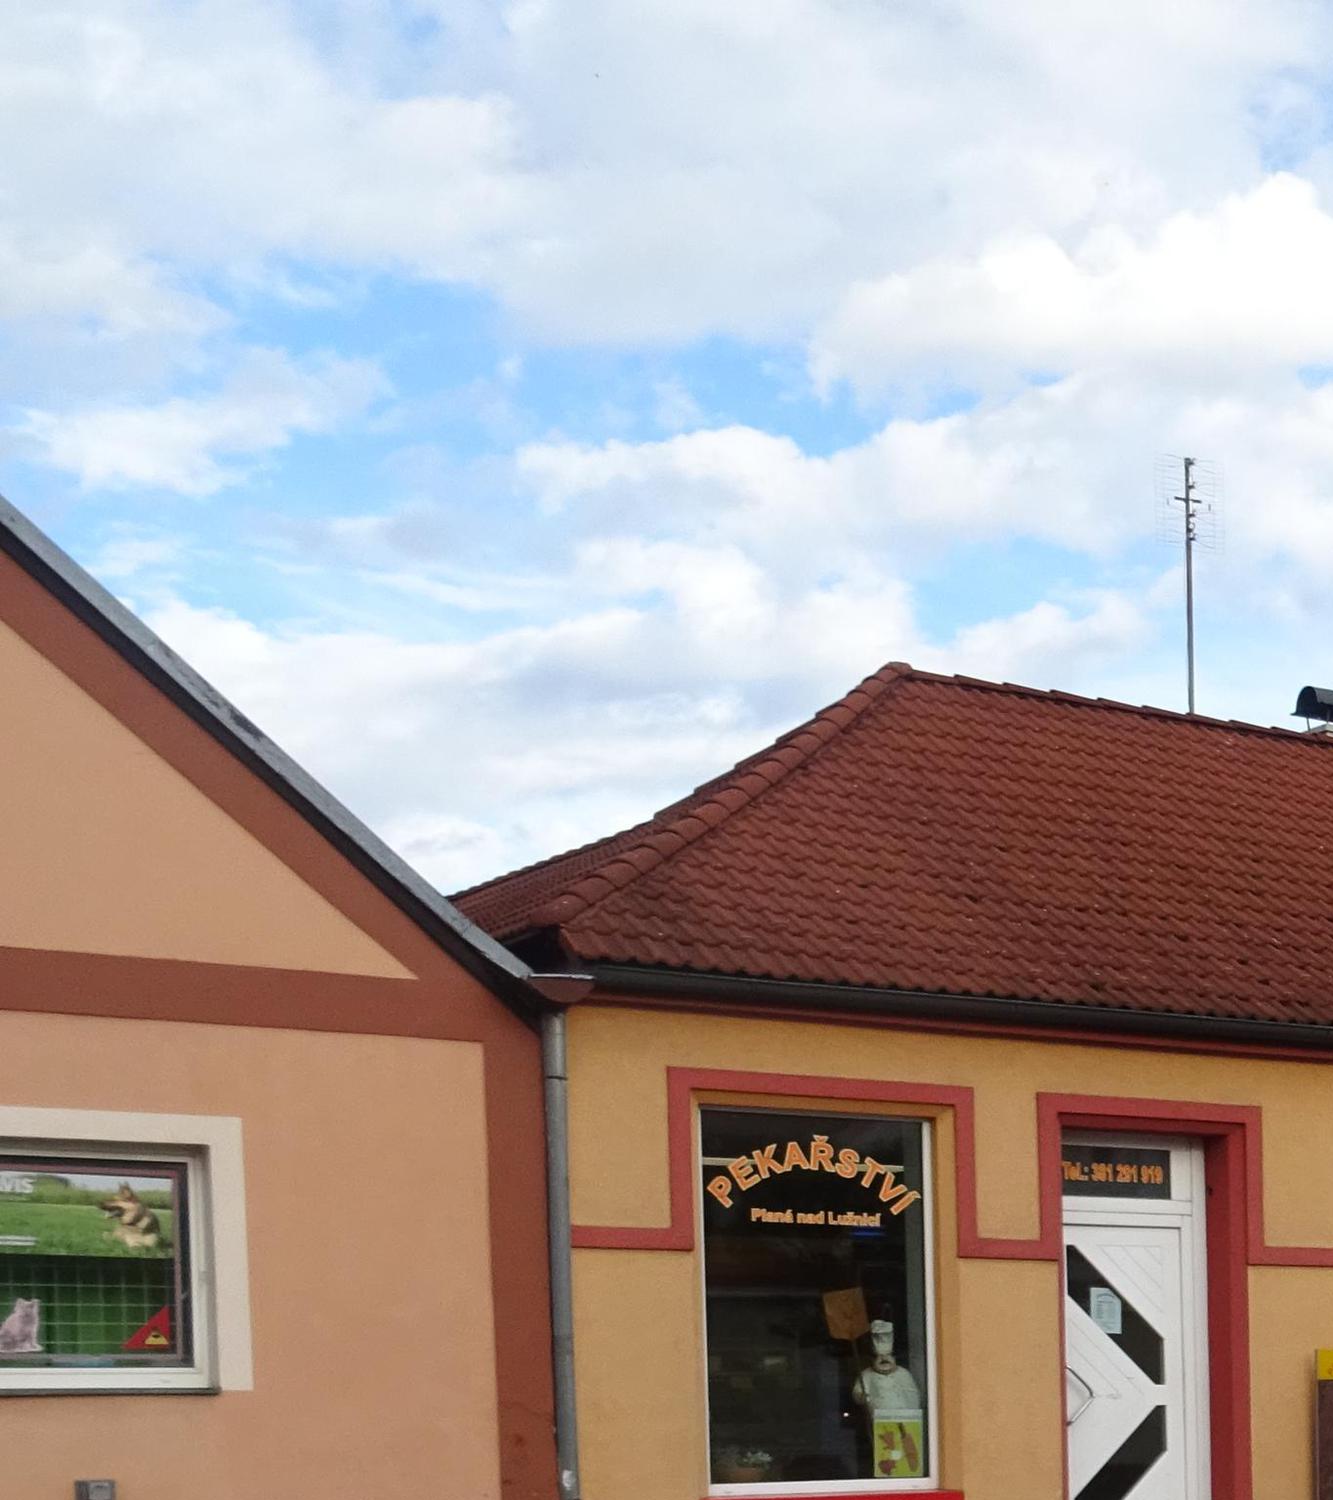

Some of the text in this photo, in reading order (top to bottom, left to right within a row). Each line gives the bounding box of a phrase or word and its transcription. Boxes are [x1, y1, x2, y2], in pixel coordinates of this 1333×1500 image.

[706, 1134, 922, 1216] PEKAŘSTVÍ
[751, 1206, 882, 1228] Planá nad Lužnicí
